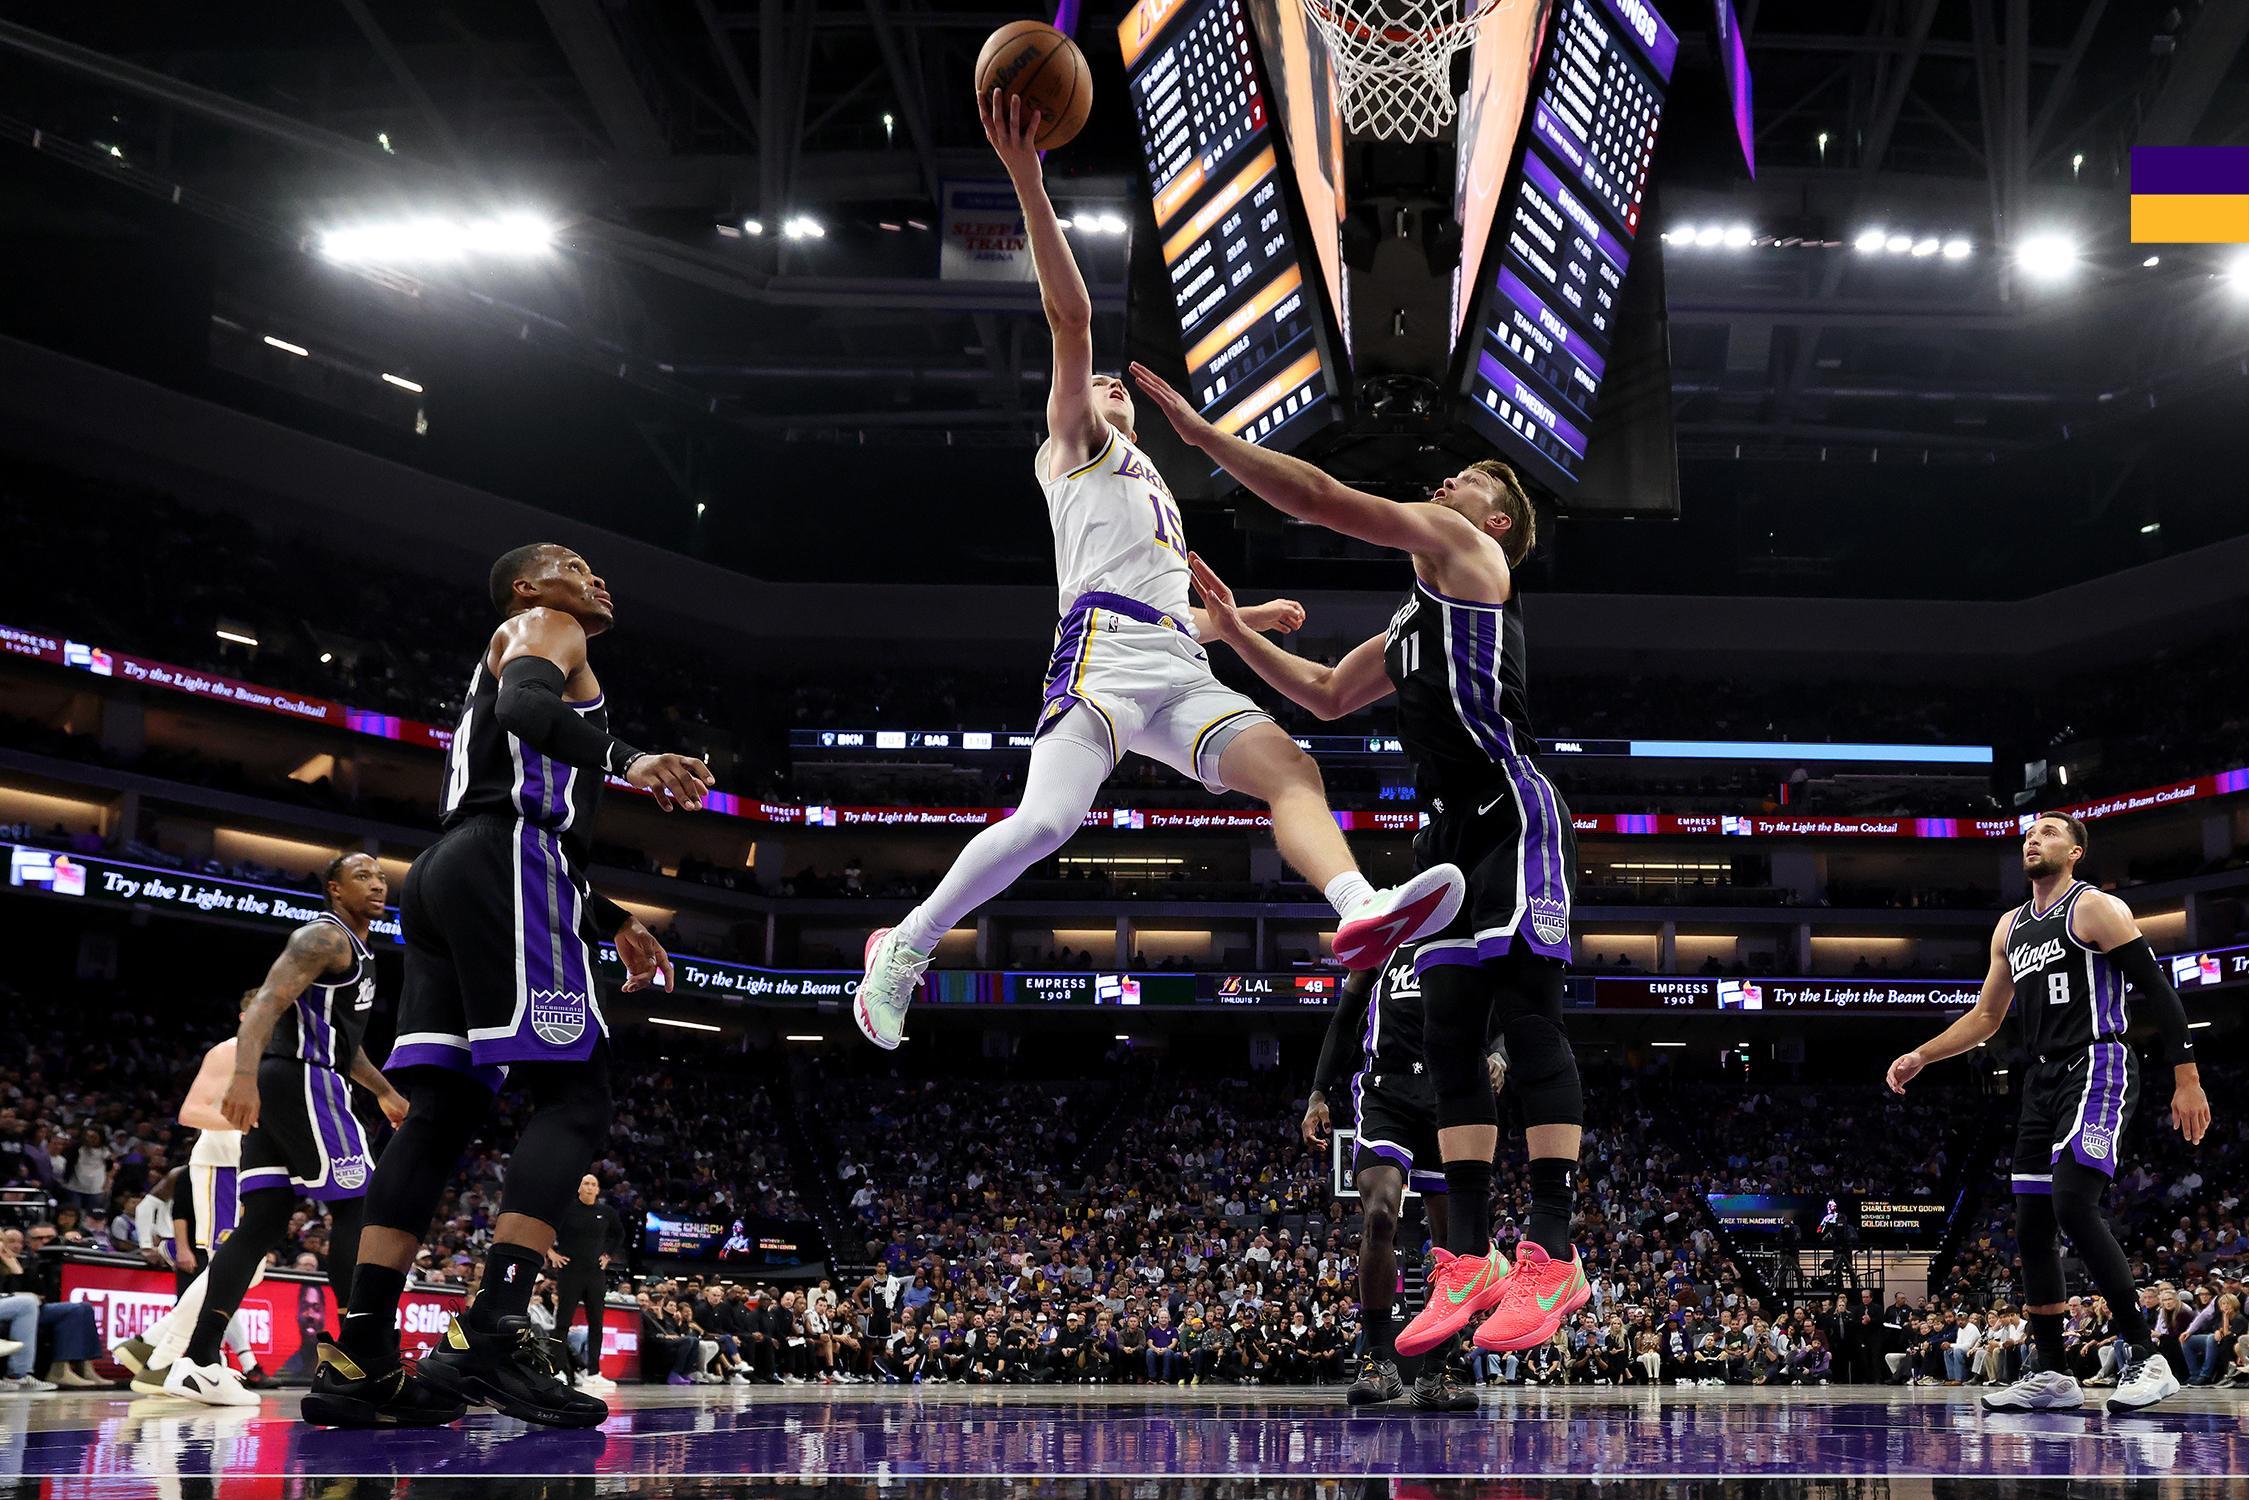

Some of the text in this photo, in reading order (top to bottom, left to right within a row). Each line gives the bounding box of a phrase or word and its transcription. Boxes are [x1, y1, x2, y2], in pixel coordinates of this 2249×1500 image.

[965, 238, 1025, 251] TRAIN
[1539, 308, 1567, 342] FOULS
[1209, 294, 1300, 374] TEAM FOULS BONUS
[1514, 310, 1596, 392] TEAM FOULS BONUS
[1515, 383, 1557, 428] TIMEOUTS
[1149, 493, 1188, 566] 15
[1401, 630, 1420, 679] 11
[124, 662, 326, 717] Try the Light the Beam Cocktail
[924, 735, 948, 746] SAS
[1555, 743, 1582, 752] FINAL
[2088, 804, 2111, 817] Light
[2113, 801, 2127, 811] the
[2128, 797, 2154, 808] Beam
[2156, 785, 2195, 802] Cocktail
[760, 804, 801, 817] EMPRESS
[844, 812, 987, 824] Try the Light the Beam Cocktail
[1152, 815, 1167, 826] Try
[1169, 815, 1183, 824] the
[1185, 815, 1209, 827] Light
[1211, 816, 1226, 825] the
[1227, 816, 1253, 825] Beam
[1375, 815, 1413, 823] EMPRESS
[1686, 825, 1708, 833] 1908
[1759, 822, 1897, 833] Try the Light the Beam Cocktail
[1976, 819, 2015, 830] EMPRESS
[103, 872, 140, 897] Try
[143, 879, 176, 899] the
[179, 882, 236, 910] Light
[237, 895, 268, 914] the
[1533, 915, 1566, 928] KINGS
[2008, 938, 2066, 982] Kings
[685, 967, 709, 987] Try
[712, 971, 733, 987] the
[736, 975, 773, 995] Light
[776, 980, 798, 994] the
[801, 981, 840, 994] Beam
[1026, 979, 1085, 988] EMPRESS
[1246, 980, 1272, 992] LAL
[1650, 984, 1708, 993] EMPRESS
[2047, 972, 2070, 1005] 8
[1040, 990, 1070, 1000] 1908
[1664, 995, 1693, 1005] 1908
[1774, 989, 1796, 1005] Try
[1800, 988, 1820, 1002] the
[1824, 989, 1860, 1006] Light
[1863, 989, 1884, 1002] the
[1887, 990, 1925, 1003] Beam
[535, 1004, 583, 1013] SACRAMENTO
[534, 1011, 584, 1025] KINGS
[334, 1168, 364, 1178] KINGS
[1861, 1204, 1945, 1213] CHARLES WESLEY GODWIN
[1749, 1217, 1777, 1226] MACHINE
[1861, 1220, 1889, 1228] GOLDEN
[683, 1222, 723, 1235] CHURCH
